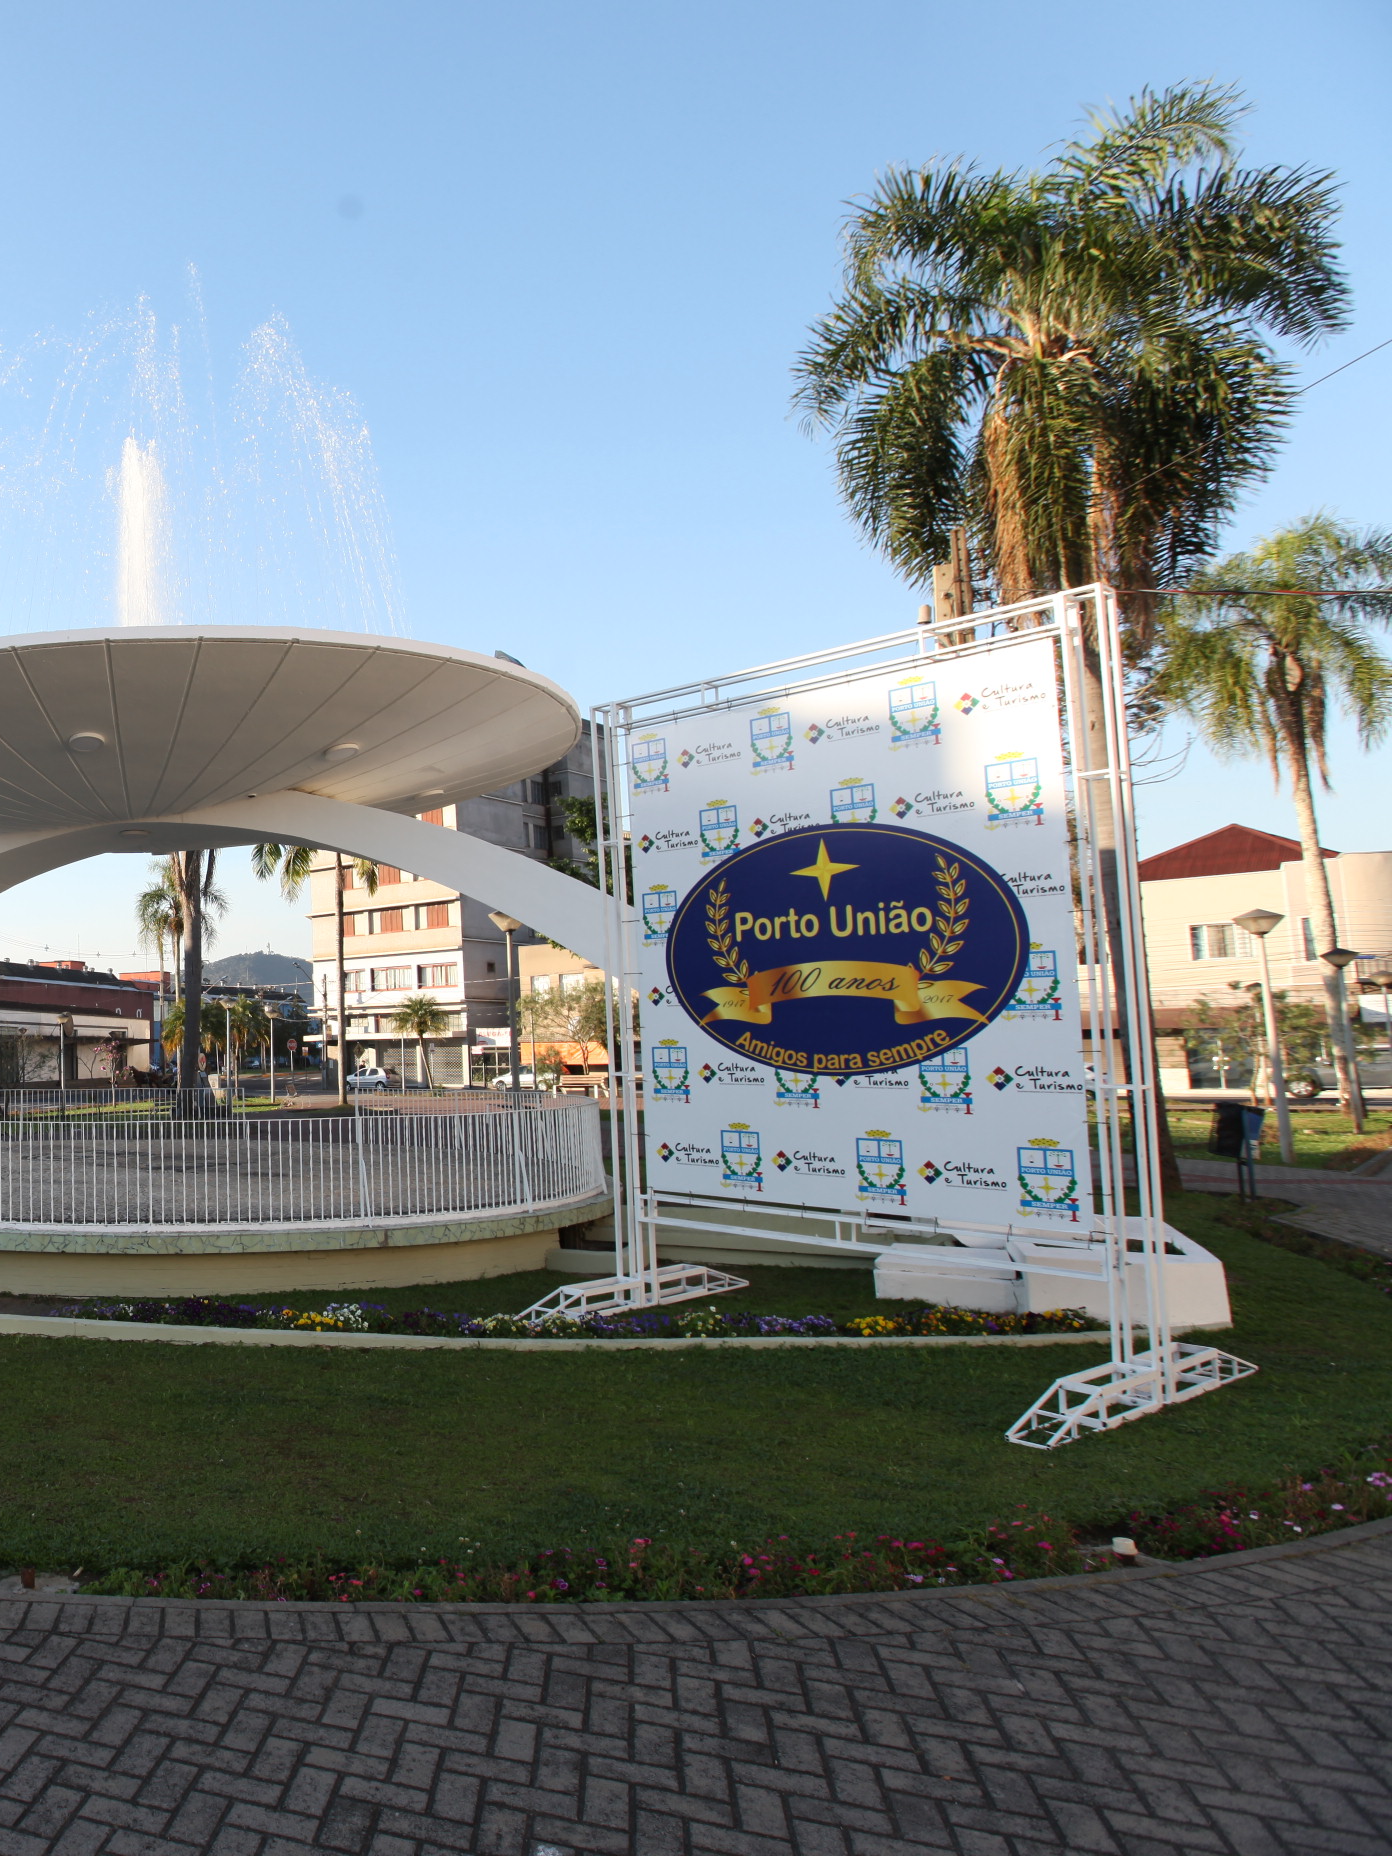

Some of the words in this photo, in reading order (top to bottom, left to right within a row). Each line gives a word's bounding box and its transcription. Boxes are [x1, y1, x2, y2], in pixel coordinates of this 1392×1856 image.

[982, 682, 1033, 698] Cultura
[995, 692, 1046, 706] Turismo
[826, 715, 870, 728] Cultura
[837, 724, 880, 737] Turismo
[696, 742, 732, 754] Cultura
[706, 751, 741, 763] Turismo
[988, 780, 1012, 789] PORTO
[914, 790, 963, 804] Cultura
[928, 802, 974, 814] Turismo
[770, 812, 810, 824] Cultura
[998, 810, 1034, 820] SEMPER
[655, 829, 690, 841] Cultura
[664, 837, 698, 848] Turismo
[1012, 884, 1065, 896] Turismo
[734, 907, 819, 942] Porto
[829, 900, 933, 938] União
[769, 967, 822, 997] 100
[828, 977, 900, 992] anos
[722, 1000, 746, 1008] 1917
[922, 995, 954, 1004] 2017
[735, 1031, 808, 1067] Amigos
[813, 1053, 863, 1073] para
[866, 1029, 951, 1067] sempre
[718, 1062, 756, 1072] Cultura
[1014, 1066, 1070, 1078] Cultura
[728, 1073, 764, 1084] Turismo
[865, 1075, 908, 1087] Turismo
[1029, 1078, 1084, 1091] Turismo
[675, 1142, 711, 1154] Cultura
[684, 1154, 720, 1165] Turismo
[794, 1150, 836, 1163] Cultura
[804, 1162, 846, 1175] Turismo
[944, 1160, 995, 1174] Cultura
[1048, 1168, 1072, 1176] UNIÃO
[957, 1174, 1007, 1188] Turismo
[1032, 1201, 1068, 1210] SEMPER
